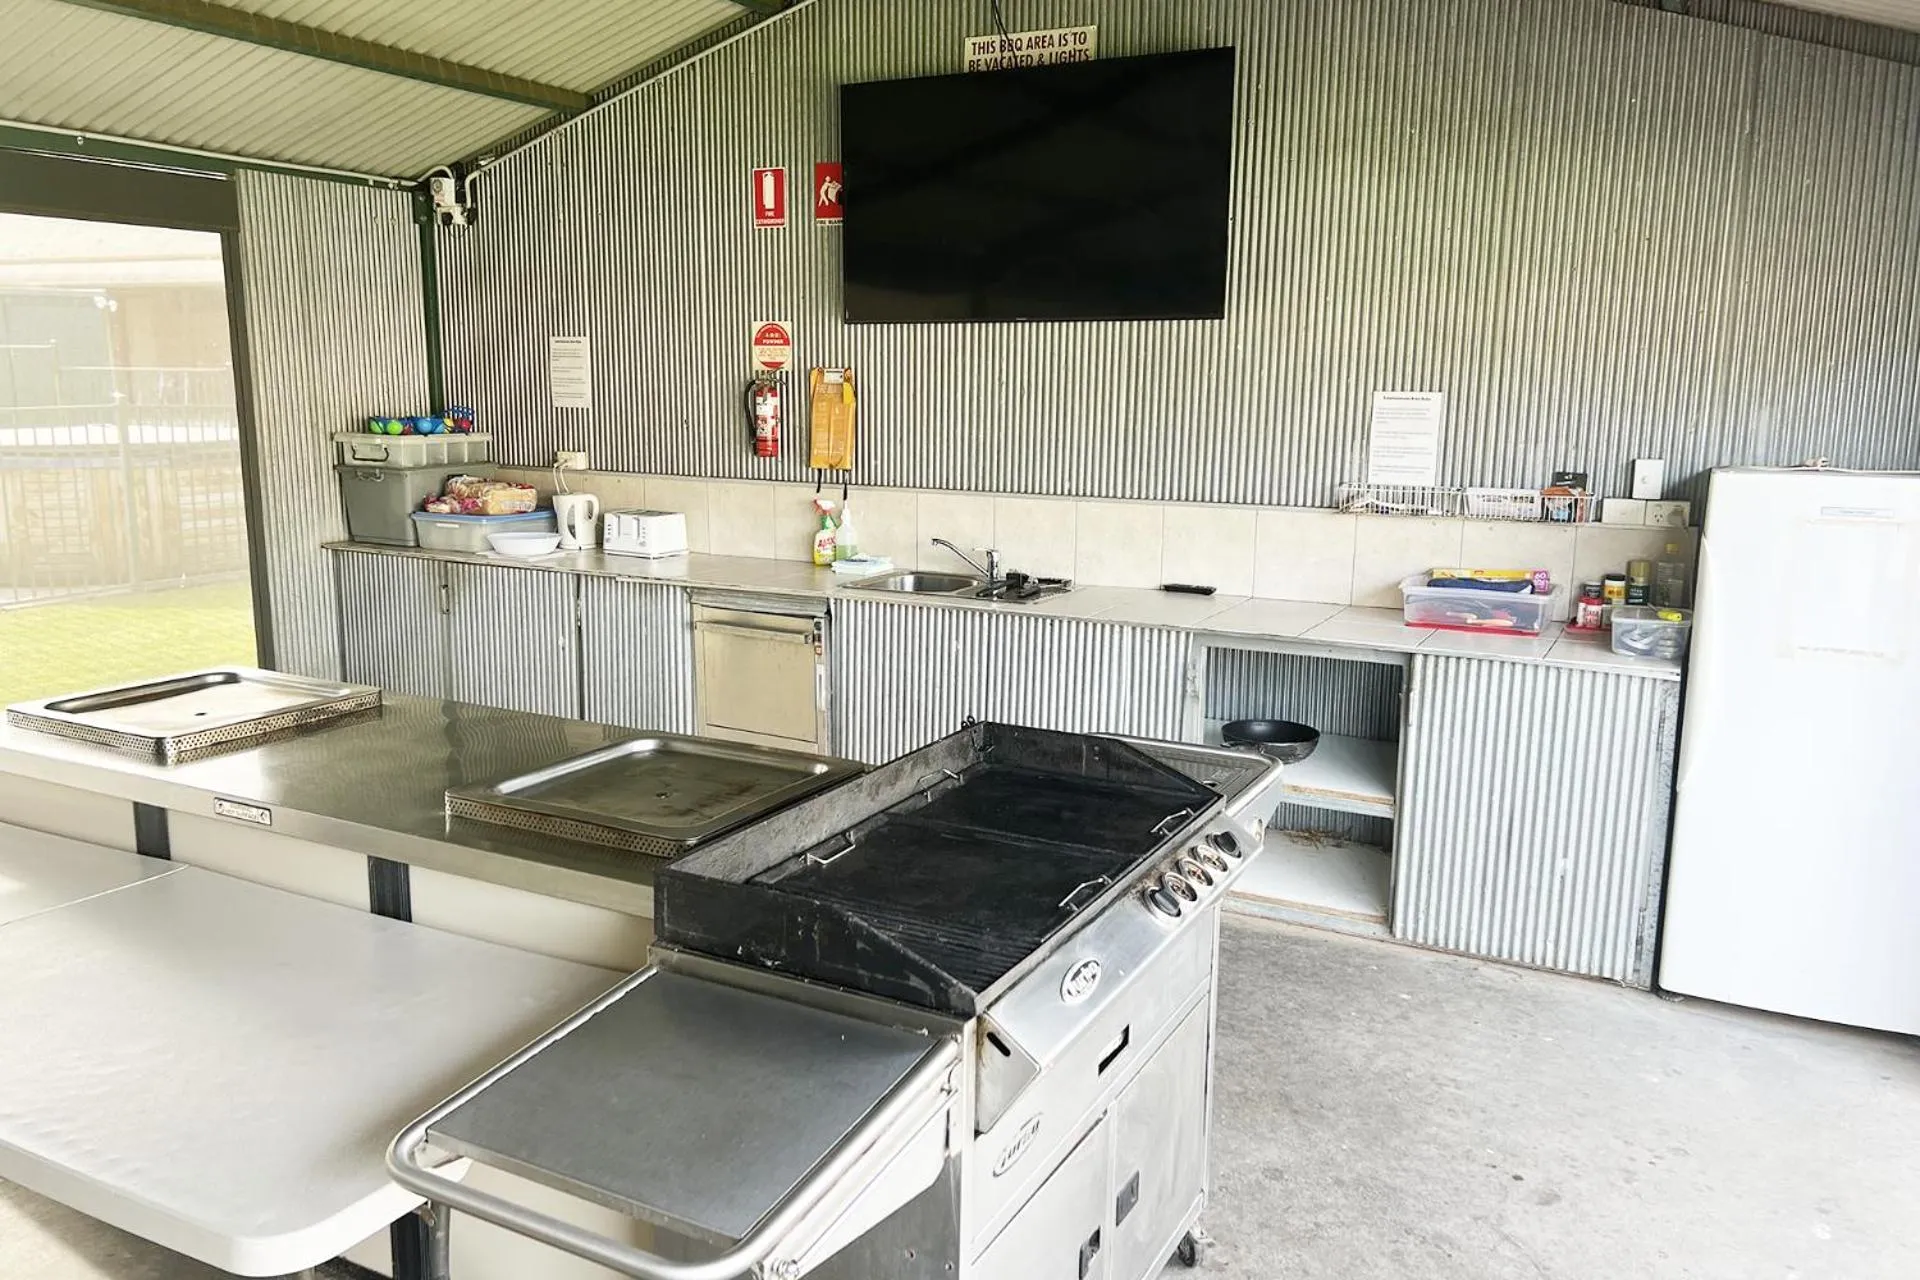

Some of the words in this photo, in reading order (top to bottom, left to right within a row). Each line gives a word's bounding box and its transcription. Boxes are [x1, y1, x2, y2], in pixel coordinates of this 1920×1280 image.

[971, 40, 996, 56] THIS
[1000, 37, 1023, 53] BBQ
[1026, 34, 1055, 51] AREA
[1059, 32, 1068, 47] IS
[1071, 31, 1088, 46] TO
[968, 58, 982, 72] BE
[984, 54, 1034, 71] VACATED
[1038, 53, 1045, 66] &
[1049, 48, 1090, 65] LIGHTS
